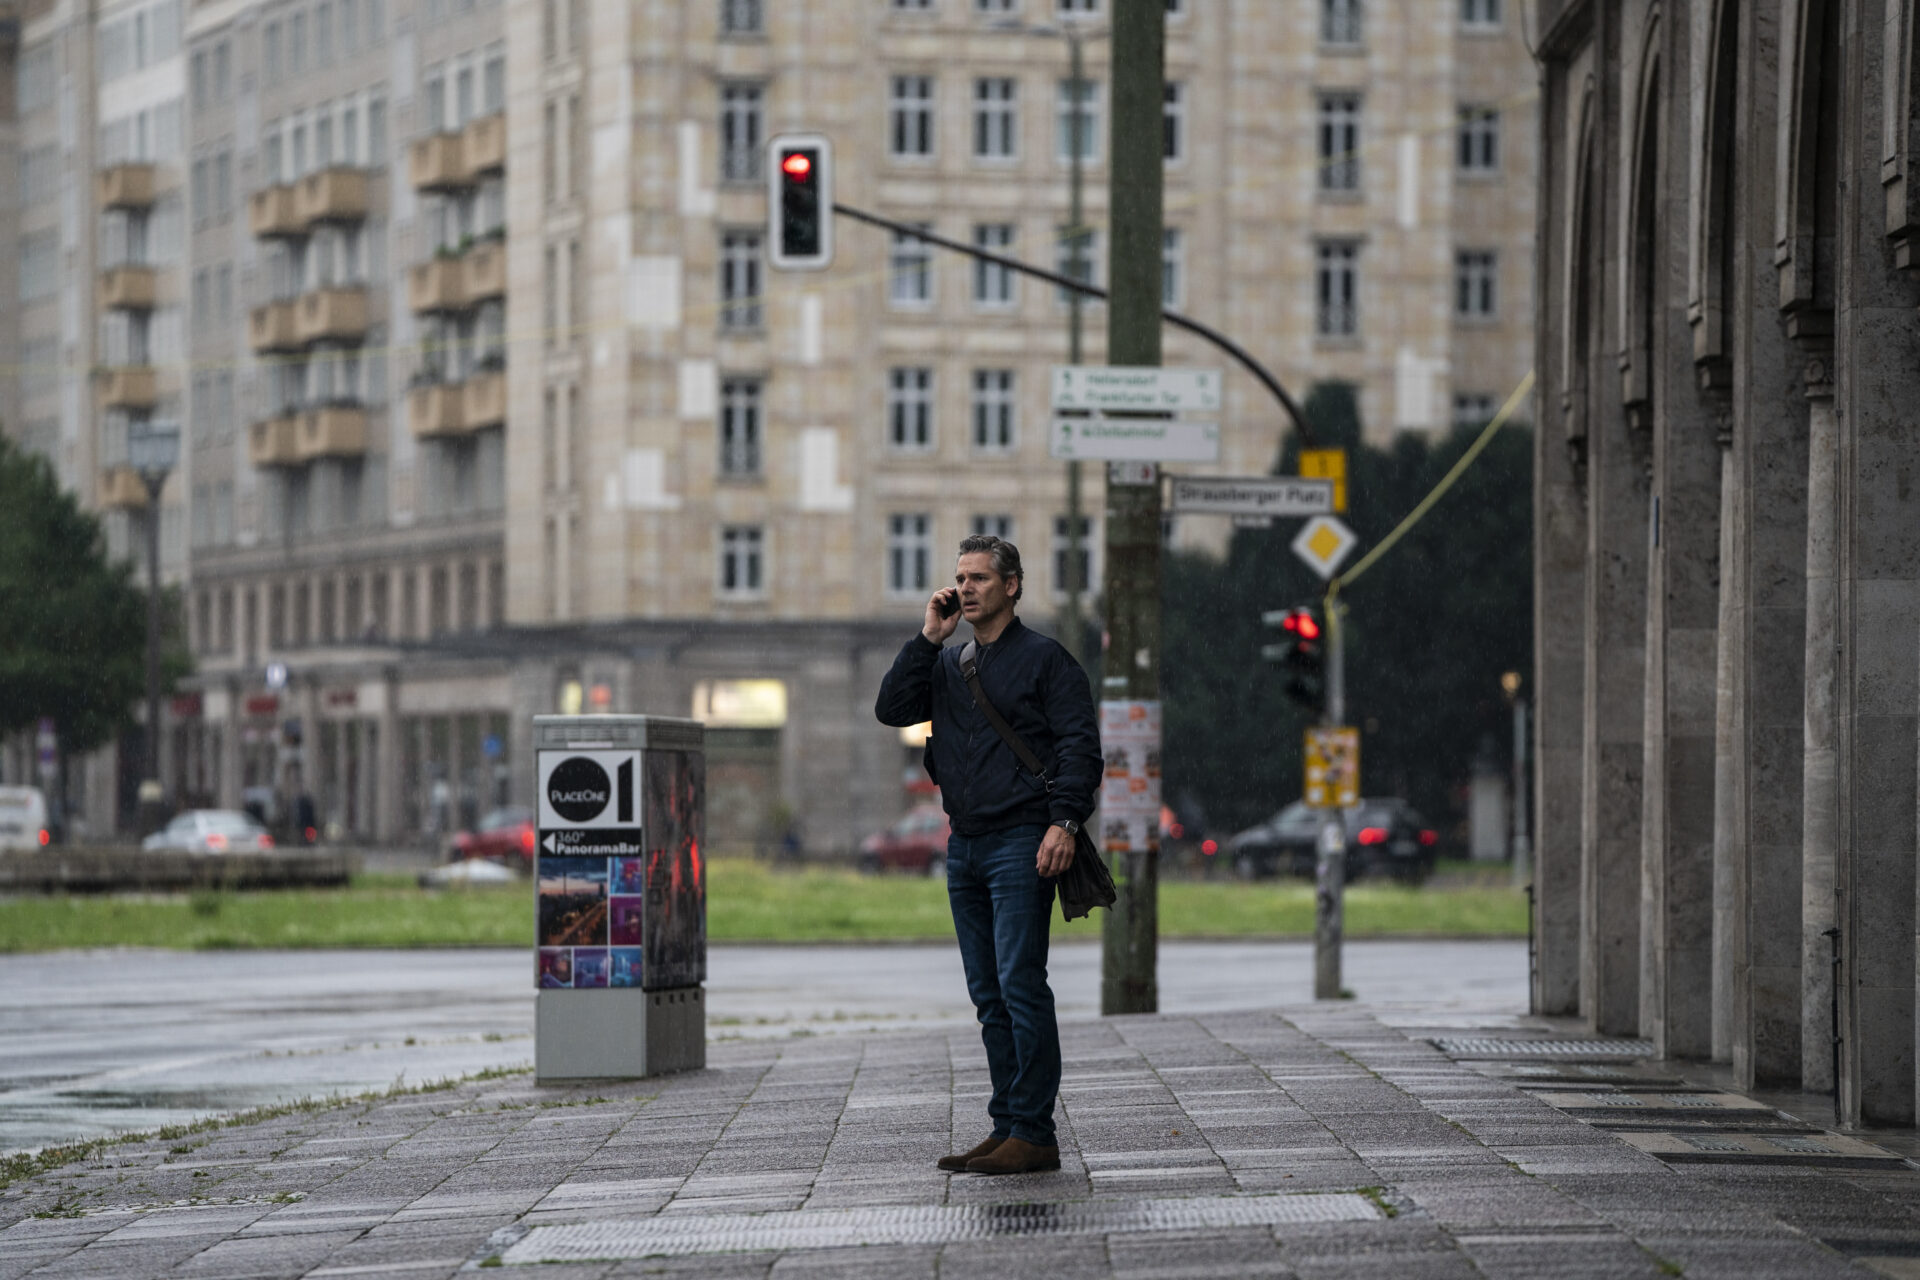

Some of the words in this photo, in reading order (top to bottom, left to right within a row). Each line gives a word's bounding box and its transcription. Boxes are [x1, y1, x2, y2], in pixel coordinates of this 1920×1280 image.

[1179, 484, 1281, 505] Strausberger
[1286, 485, 1325, 504] Platz
[557, 830, 585, 843] 360°
[557, 842, 640, 855] PanoramaBar
